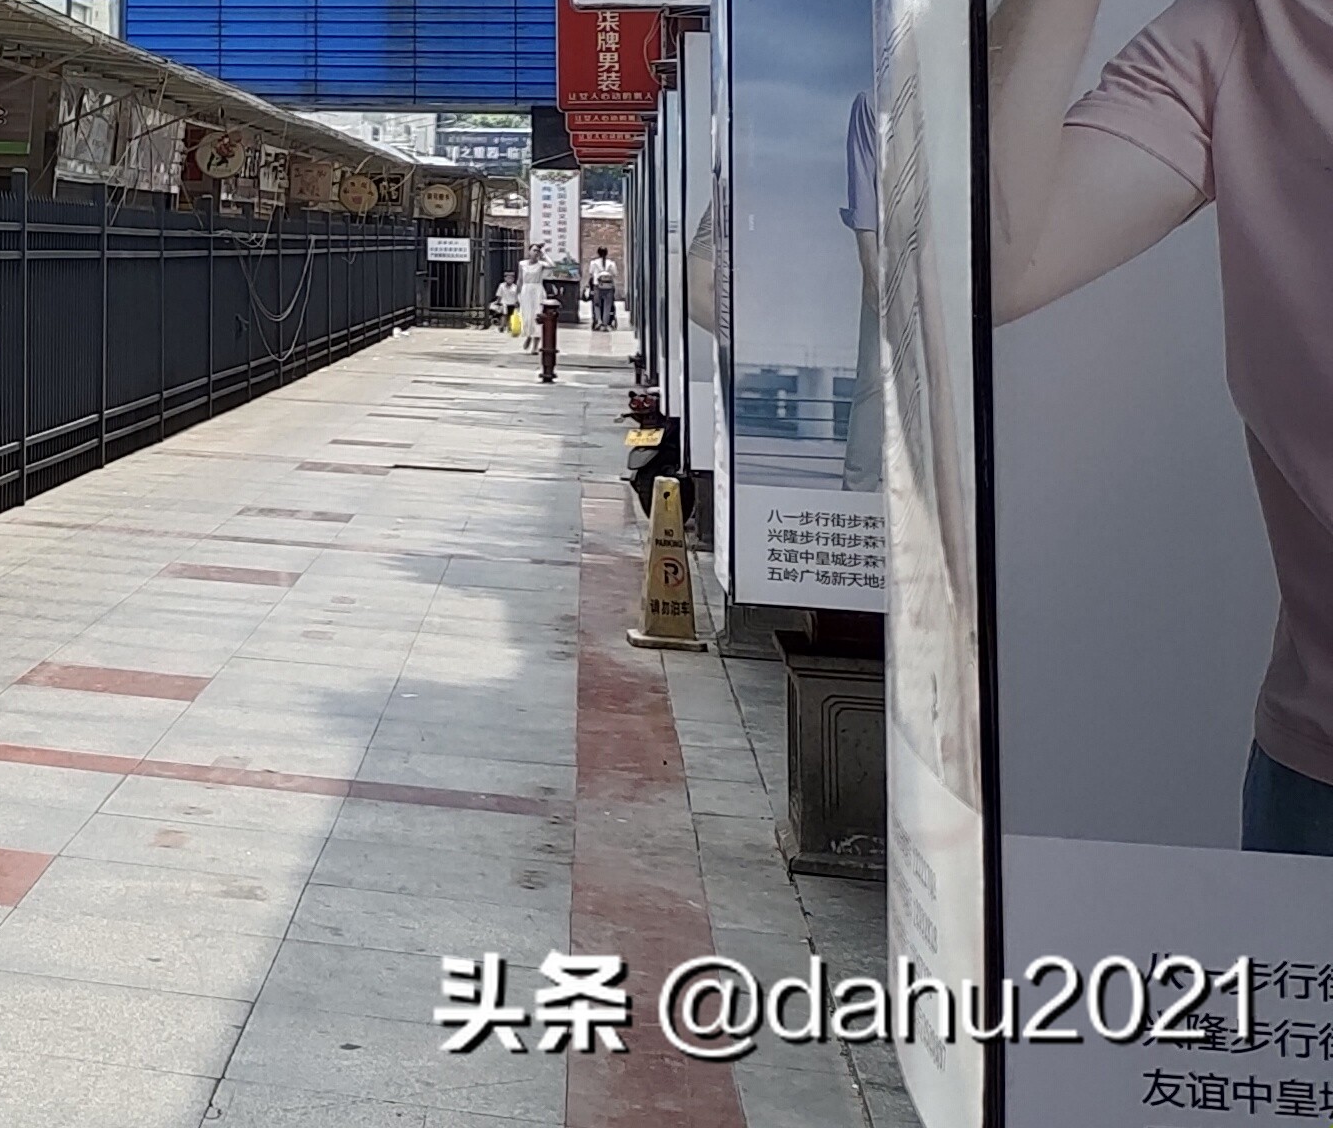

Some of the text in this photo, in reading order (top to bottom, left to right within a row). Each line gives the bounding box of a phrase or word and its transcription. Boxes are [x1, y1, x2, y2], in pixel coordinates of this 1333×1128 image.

[767, 509, 885, 530] 八一步行街步森
[664, 528, 674, 538] NO
[767, 528, 885, 550] 兴隆步行街步森
[655, 538, 683, 549] PARKING
[767, 547, 885, 569] 友谊中皇城步森
[649, 599, 691, 617] 请勿泊车
